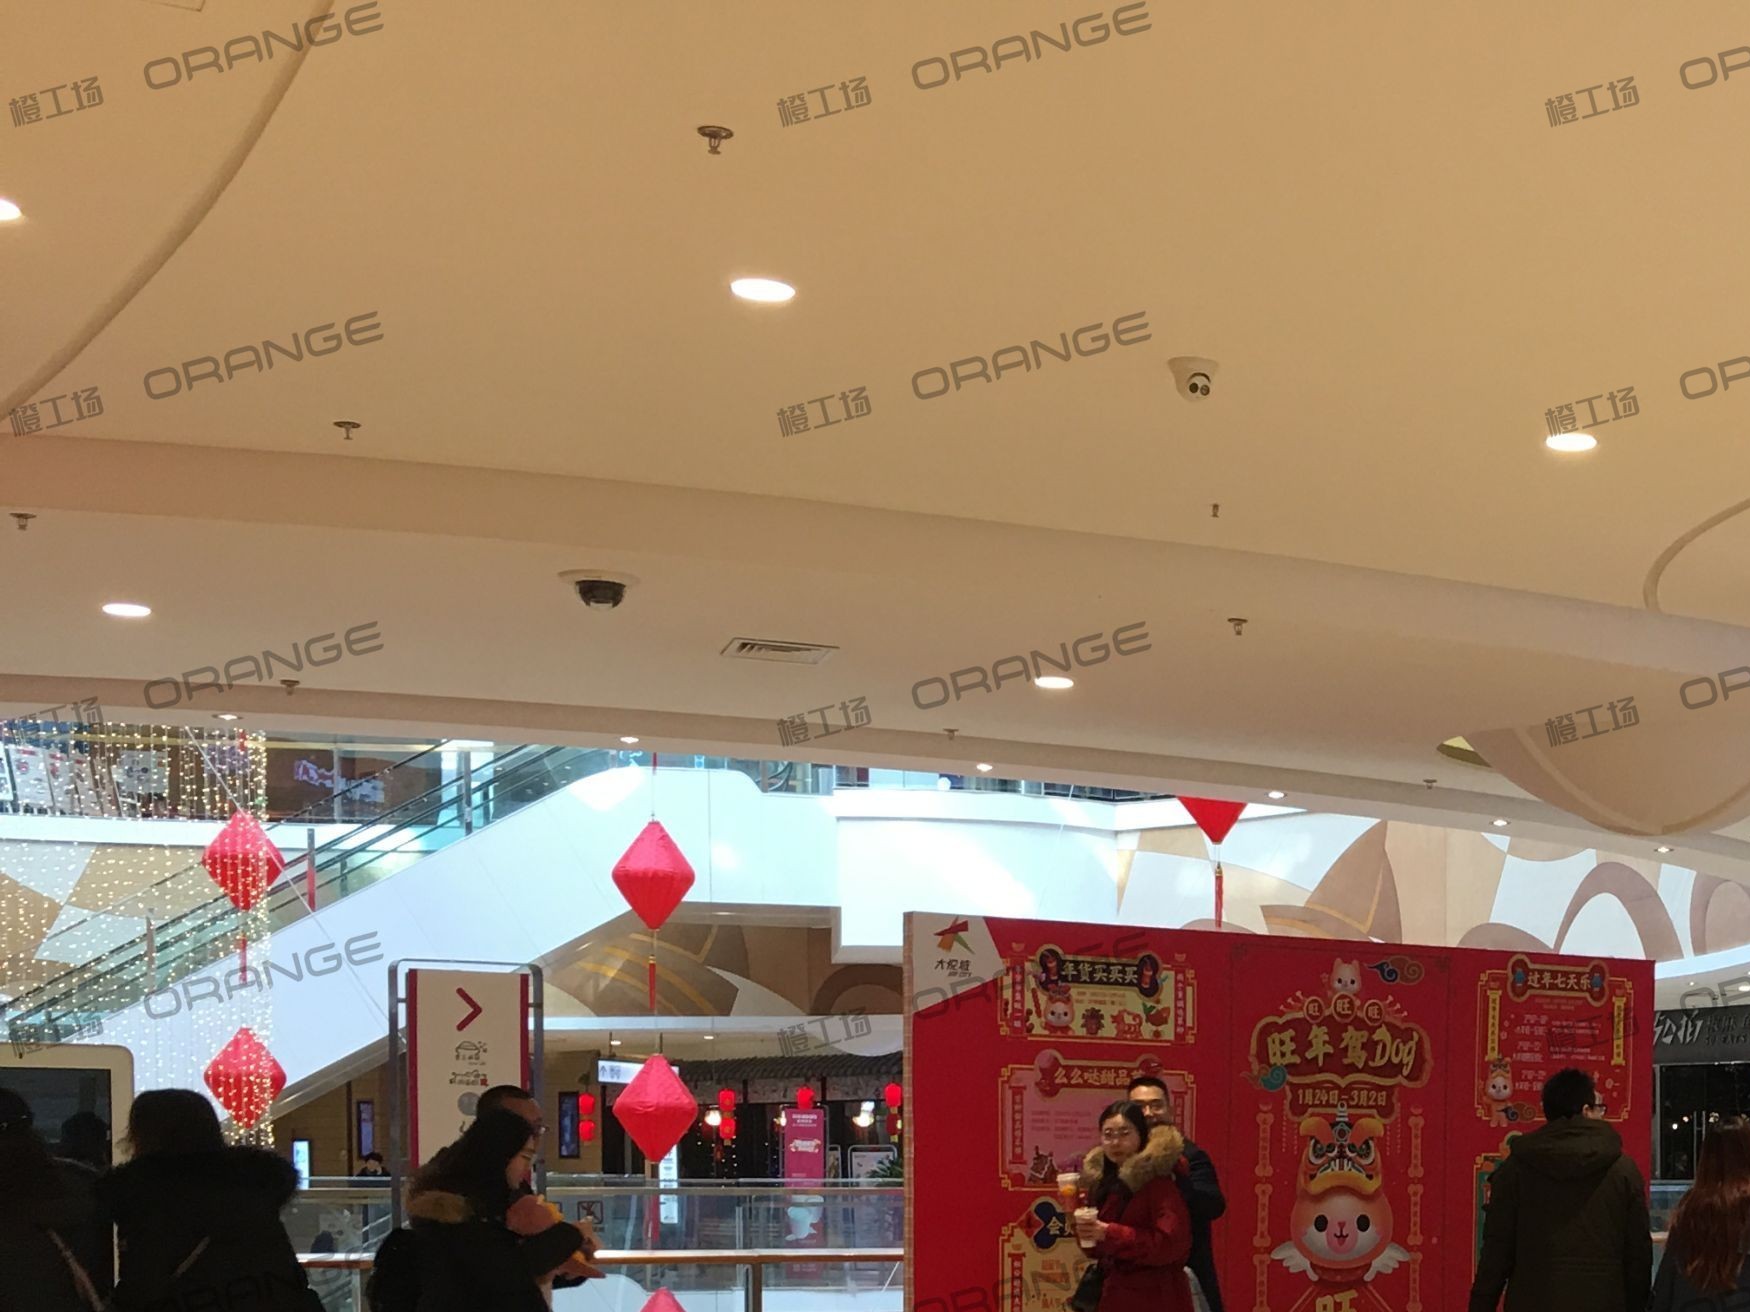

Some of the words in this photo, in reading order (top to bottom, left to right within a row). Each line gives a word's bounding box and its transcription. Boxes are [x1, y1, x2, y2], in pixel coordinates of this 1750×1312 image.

[1062, 962, 1138, 983] 年货买买买
[1528, 971, 1592, 990] 过年七天乐
[1308, 1003, 1320, 1016] 旺
[1336, 999, 1352, 1016] 旺
[1368, 1006, 1381, 1019] 旺
[1054, 1068, 1143, 1086] 么么哒甜品
